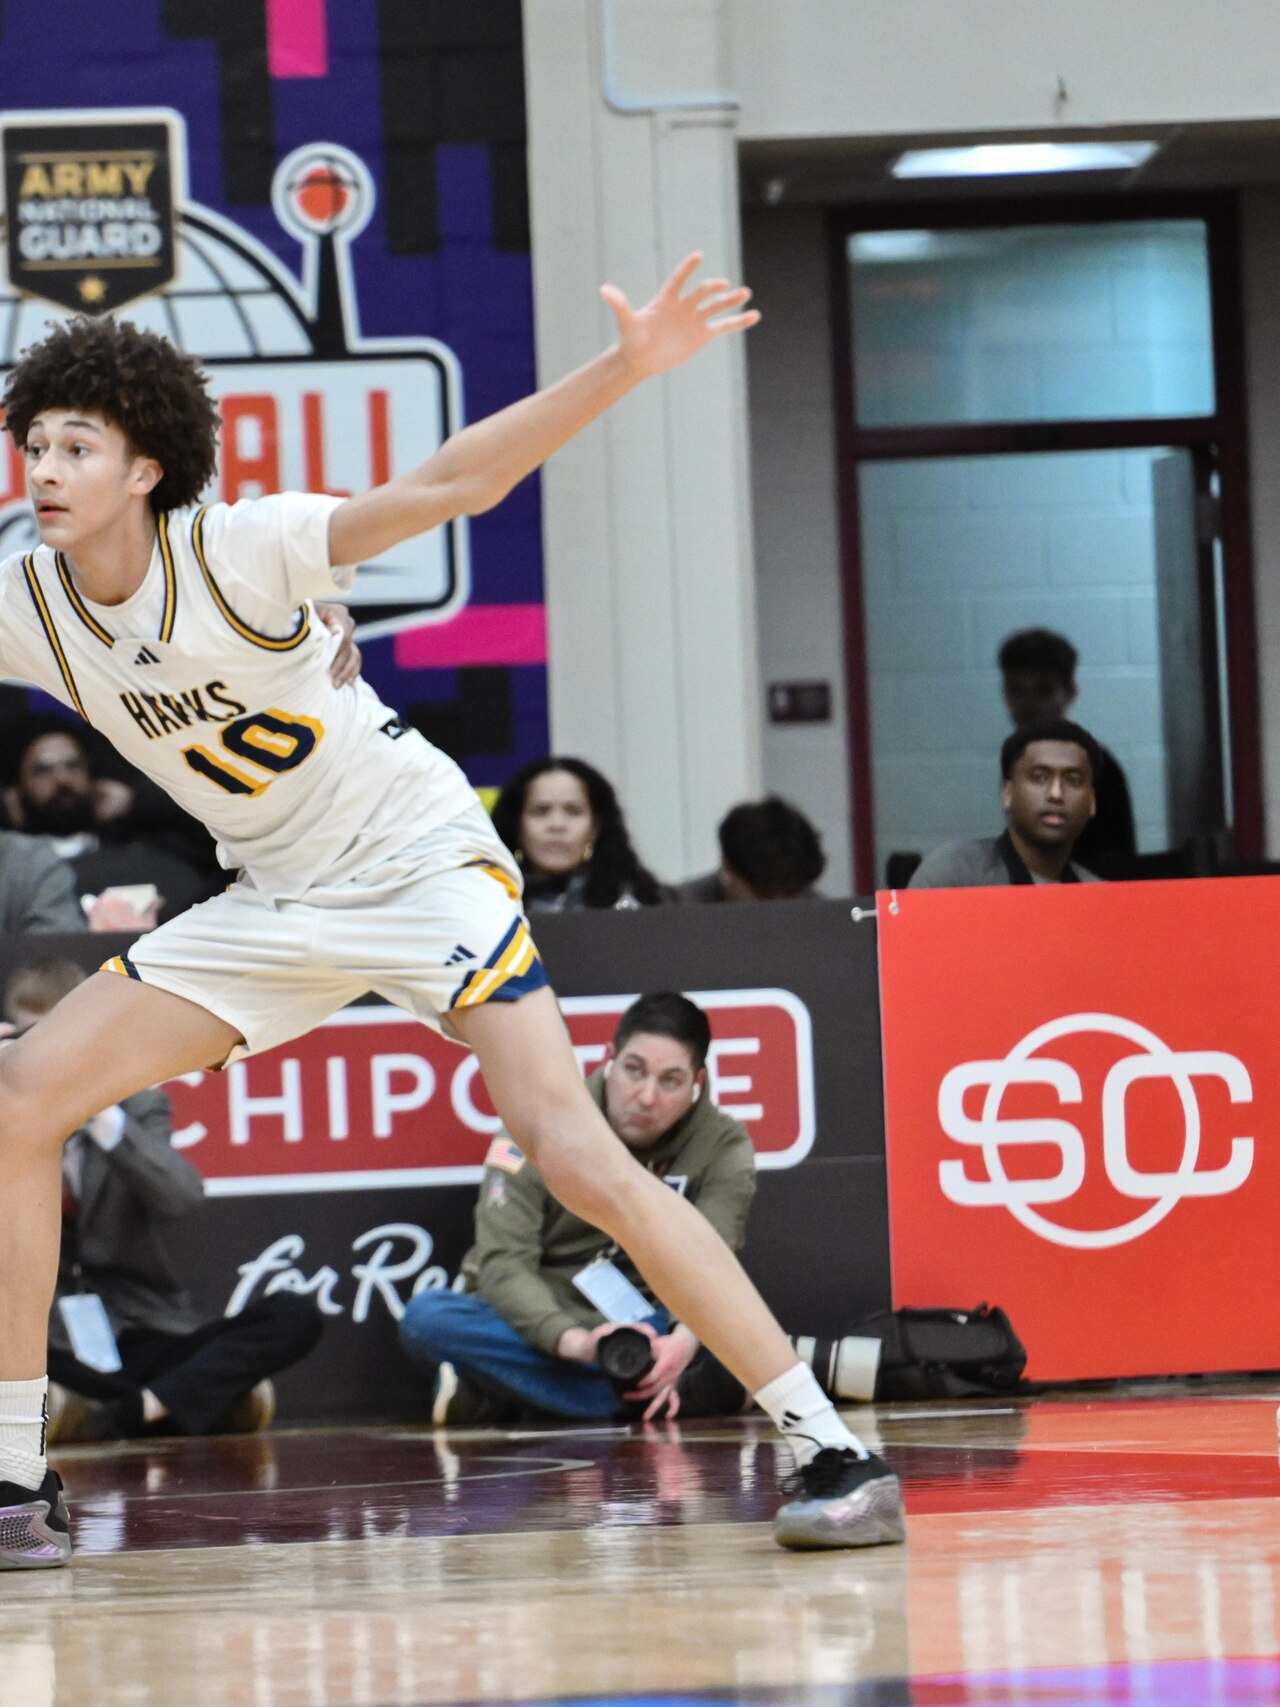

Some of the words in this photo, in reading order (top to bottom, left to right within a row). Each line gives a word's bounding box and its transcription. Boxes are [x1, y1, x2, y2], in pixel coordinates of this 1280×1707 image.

[20, 161, 157, 196] ARMY
[17, 220, 163, 261] GUARD
[119, 679, 248, 740] HAWKS
[179, 706, 326, 799] 10
[937, 1050, 1255, 1208] SC
[351, 1222, 467, 1323] Re
